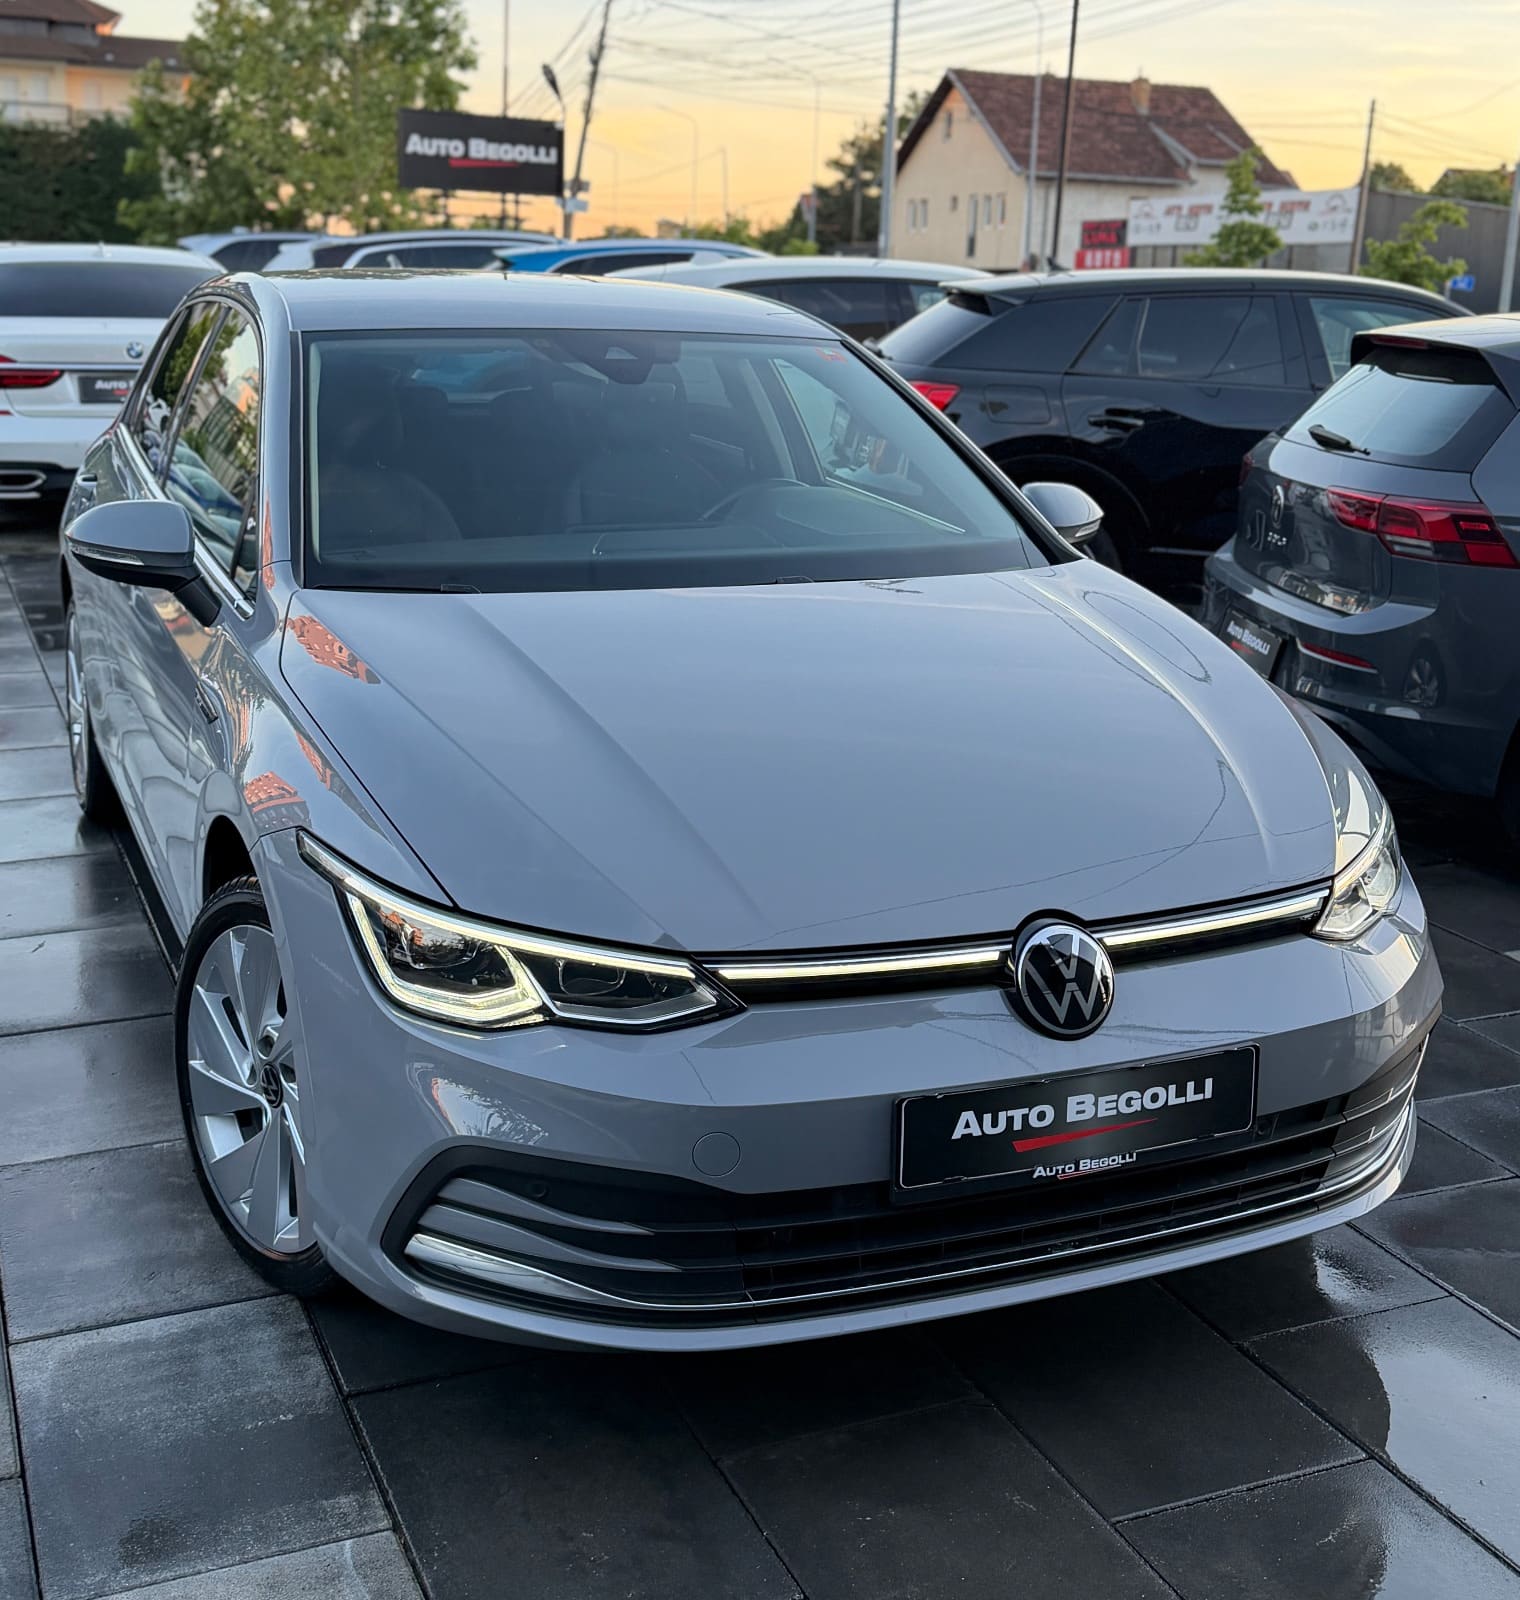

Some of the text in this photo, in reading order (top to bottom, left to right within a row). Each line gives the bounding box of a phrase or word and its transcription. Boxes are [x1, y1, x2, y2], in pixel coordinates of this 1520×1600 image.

[406, 133, 558, 164] AUTO BEGOLLI
[951, 1077, 1213, 1140] AUTO BEGOLLI
[1032, 1152, 1137, 1179] AUTO BEGOLLI
